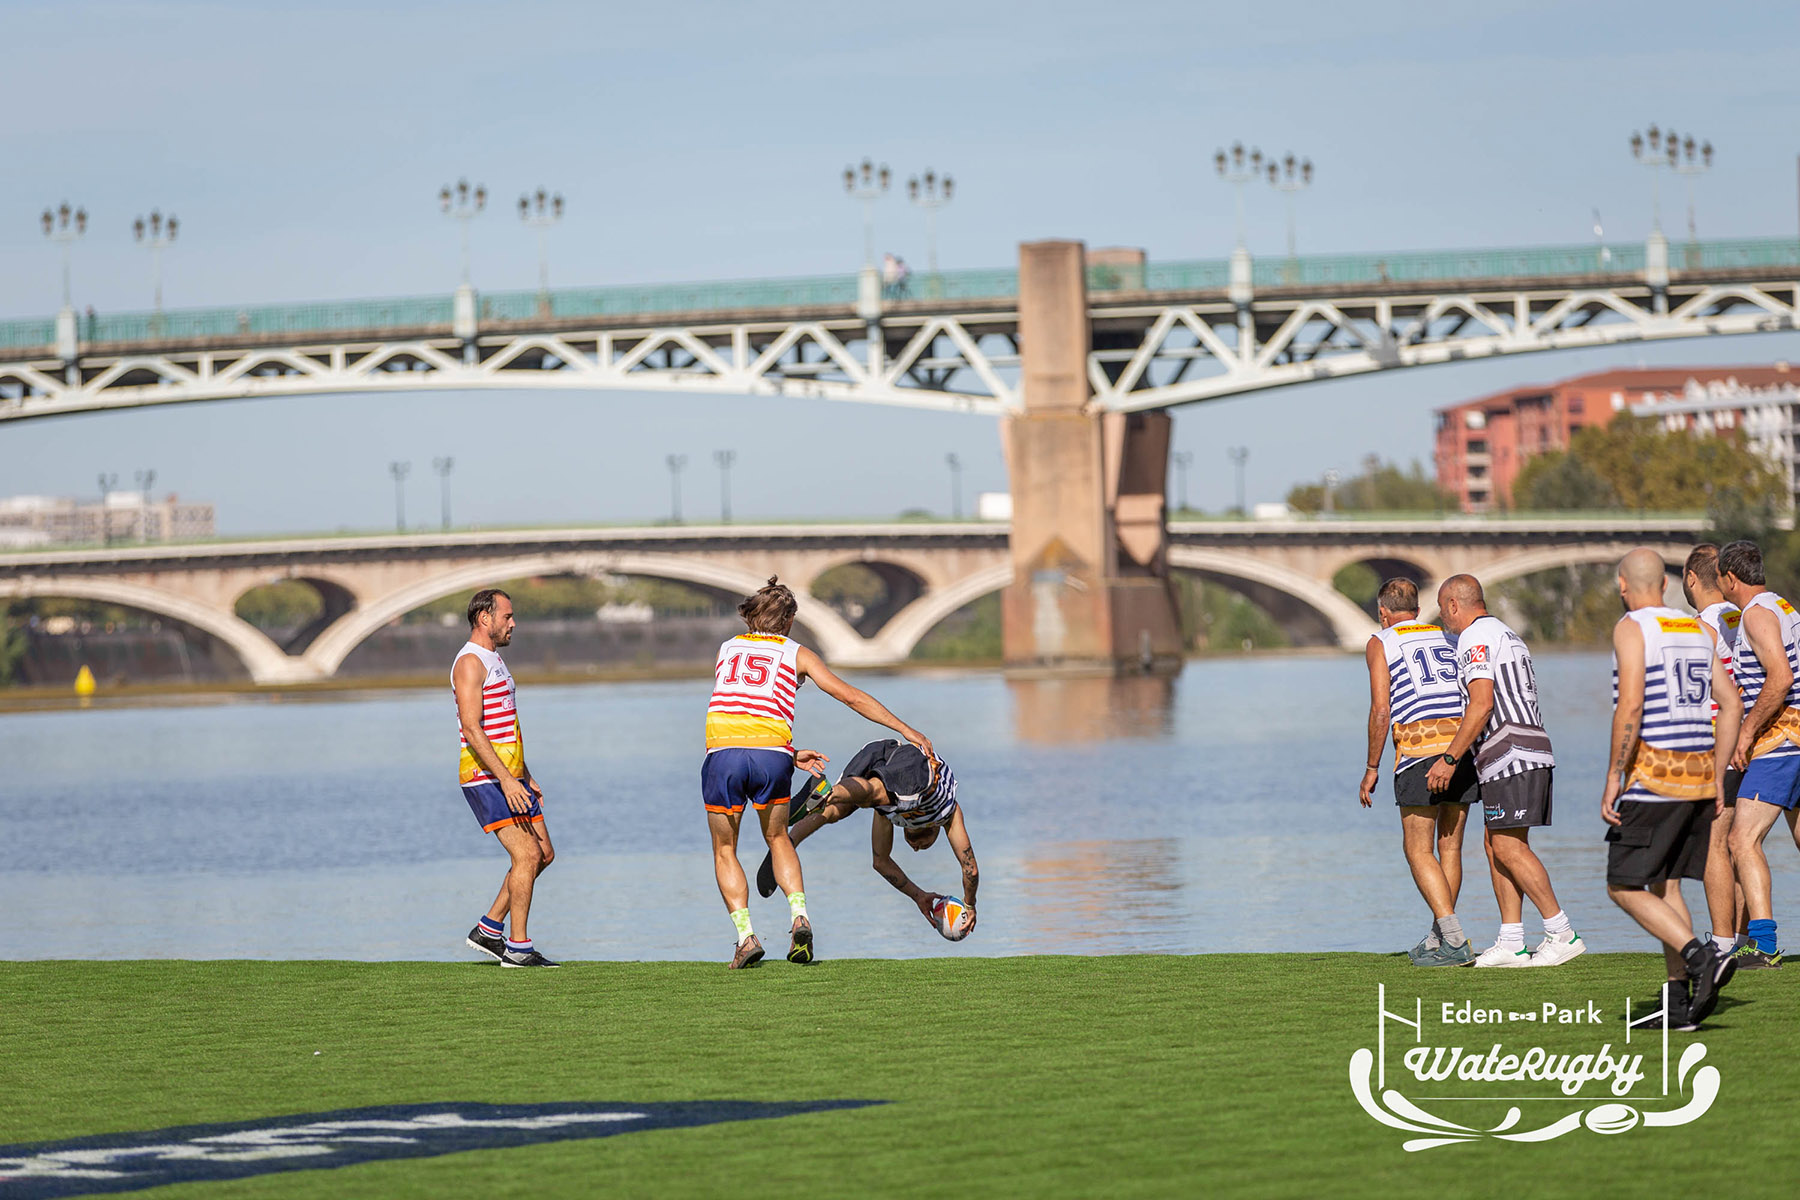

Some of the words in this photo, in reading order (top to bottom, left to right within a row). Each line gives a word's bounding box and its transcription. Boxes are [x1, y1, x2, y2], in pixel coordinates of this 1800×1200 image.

[723, 652, 774, 688] 15
[1412, 645, 1459, 686] 15
[1673, 658, 1711, 708] 15
